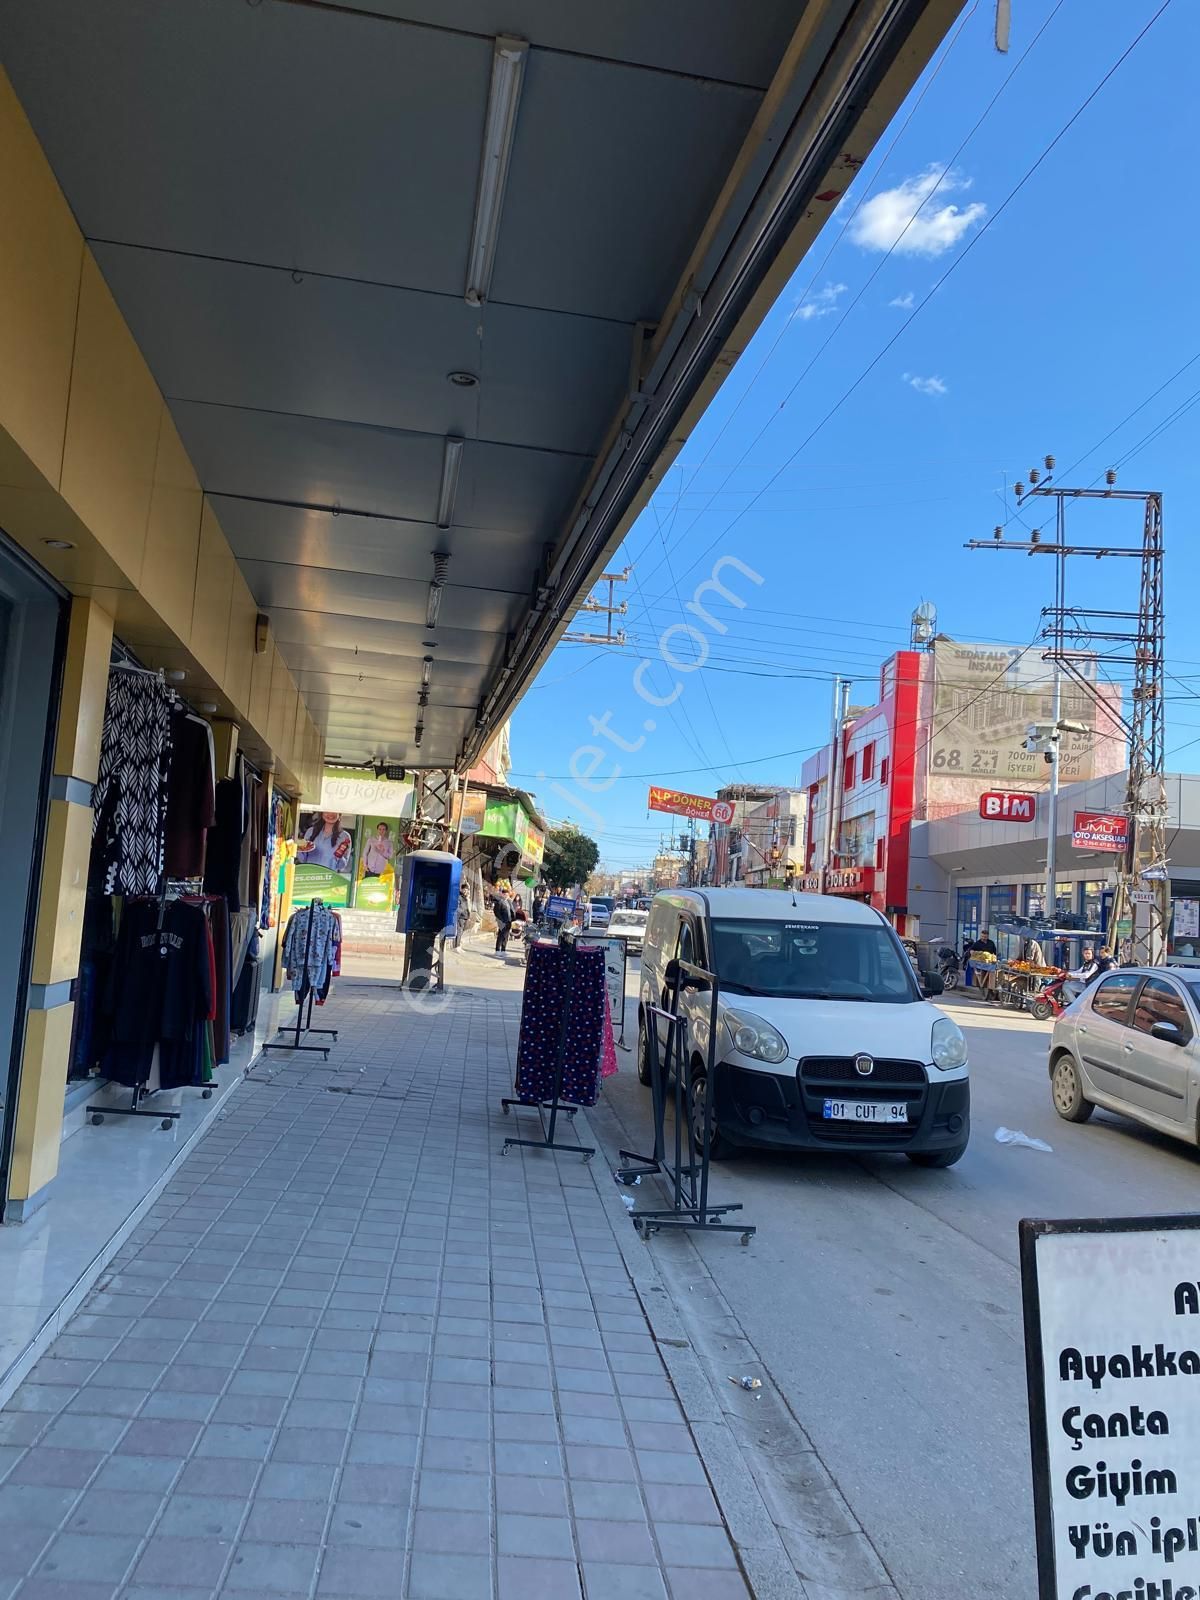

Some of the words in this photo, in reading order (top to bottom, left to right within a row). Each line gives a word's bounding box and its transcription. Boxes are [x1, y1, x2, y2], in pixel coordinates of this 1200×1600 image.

[932, 748, 961, 768] 68
[1007, 762, 1036, 773] İŞYERİ
[672, 793, 711, 809] DÖNER
[986, 793, 1030, 817] BİM
[1079, 822, 1122, 834] UMUT
[1091, 833, 1126, 843] AKSESUAR
[832, 1103, 845, 1117] 01
[855, 1105, 877, 1119] CUT
[891, 1106, 905, 1119] 94
[1174, 1281, 1200, 1315] A
[1059, 1344, 1200, 1389] Ayakka
[1062, 1406, 1169, 1451] Çanta
[1066, 1459, 1177, 1507] Giyim
[1069, 1522, 1138, 1560] Yün
[1151, 1516, 1200, 1563] ipl
